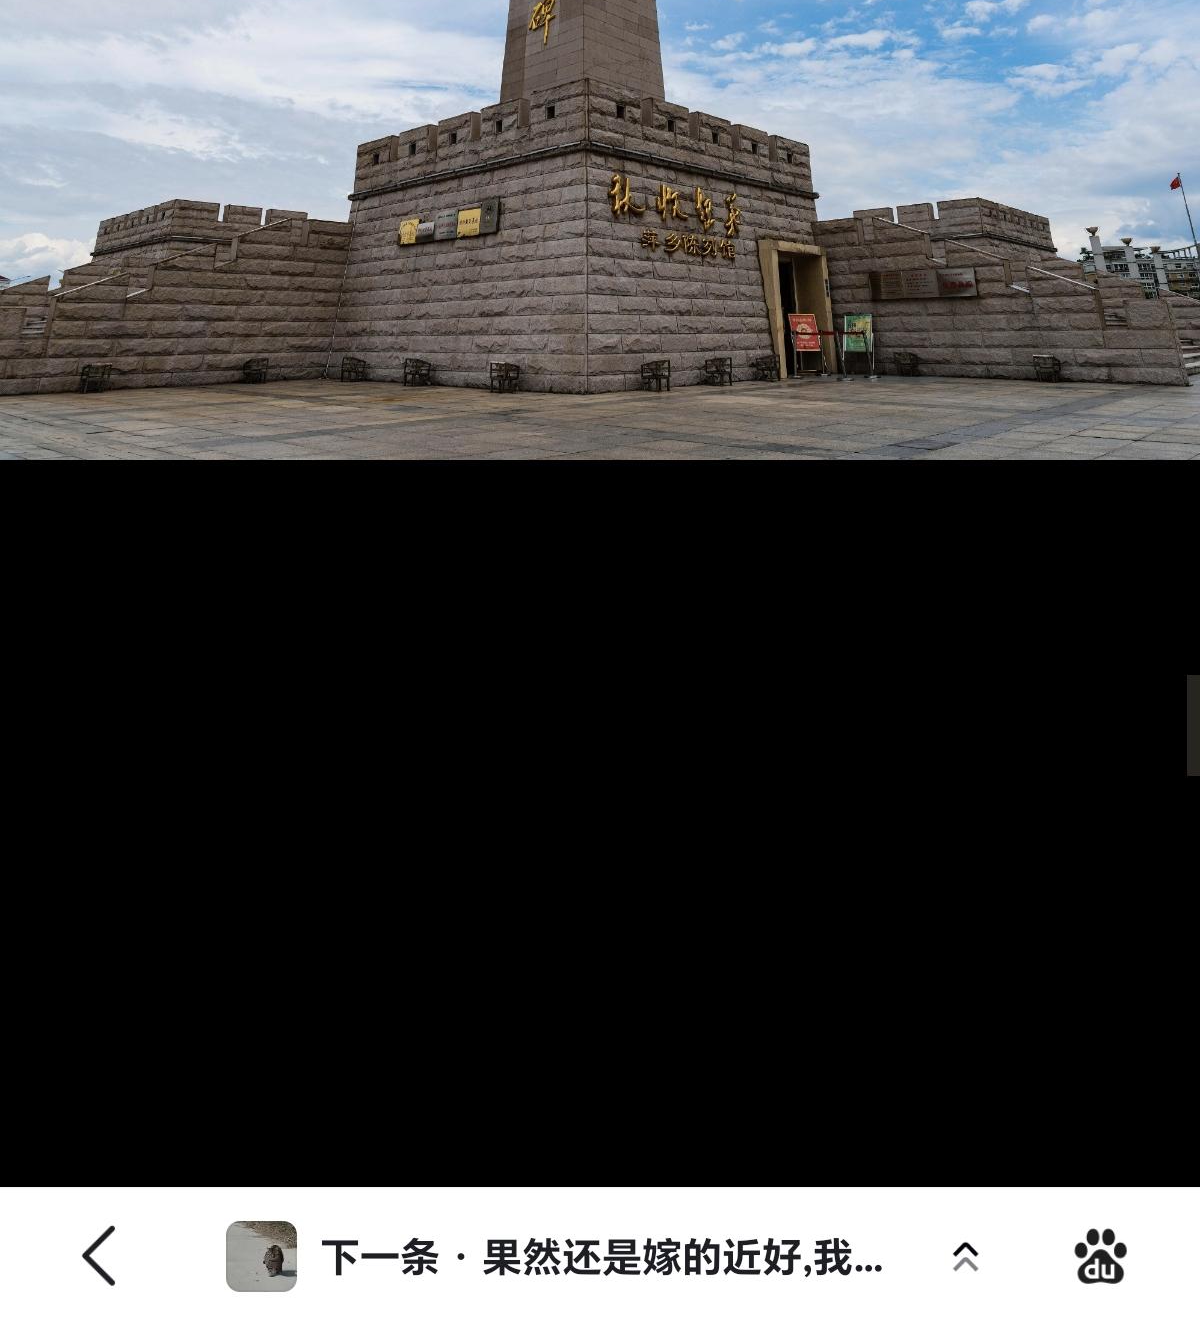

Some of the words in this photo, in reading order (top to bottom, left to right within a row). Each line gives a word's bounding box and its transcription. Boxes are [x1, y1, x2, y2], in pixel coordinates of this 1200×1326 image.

[641, 230, 735, 258] 萍乡陈列馆
[1084, 1258, 1115, 1279] du
